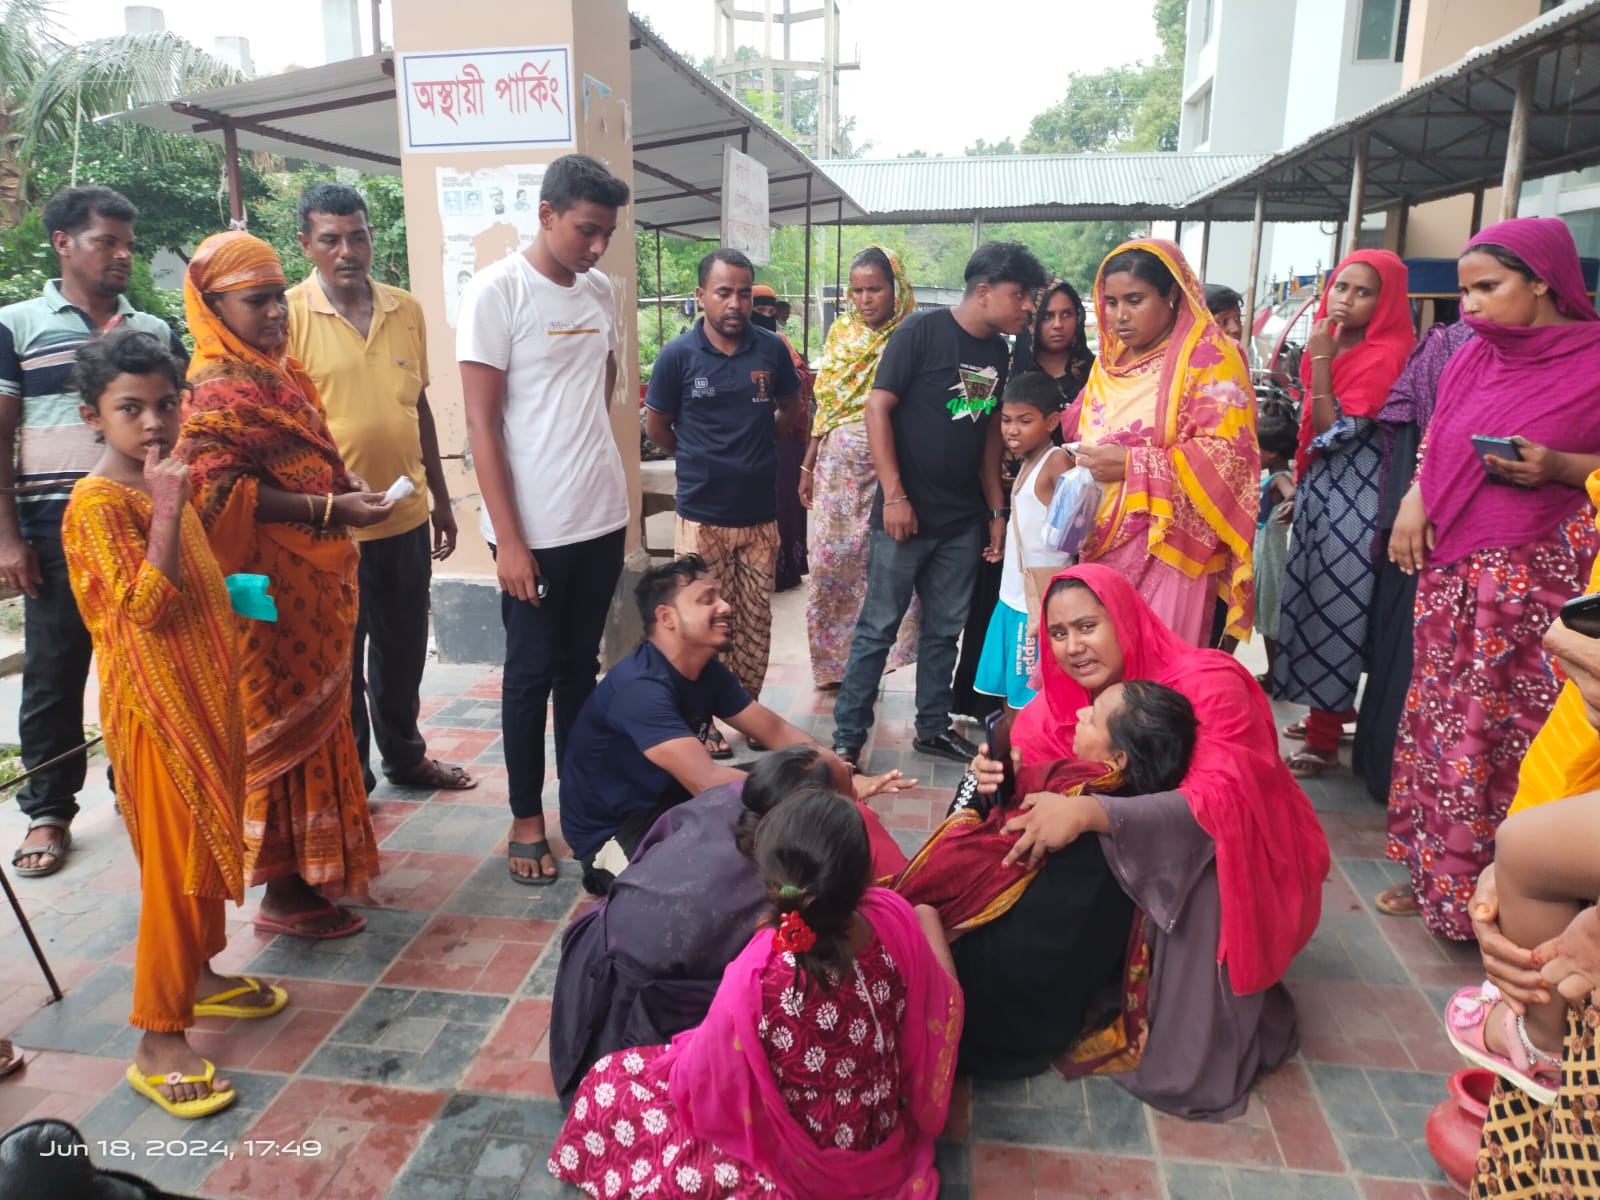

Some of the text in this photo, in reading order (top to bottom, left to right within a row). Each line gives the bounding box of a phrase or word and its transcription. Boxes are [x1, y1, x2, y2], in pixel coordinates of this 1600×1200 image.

[411, 59, 564, 126] অস্থায়ী পার্কিং
[1022, 624, 1036, 675] appa
